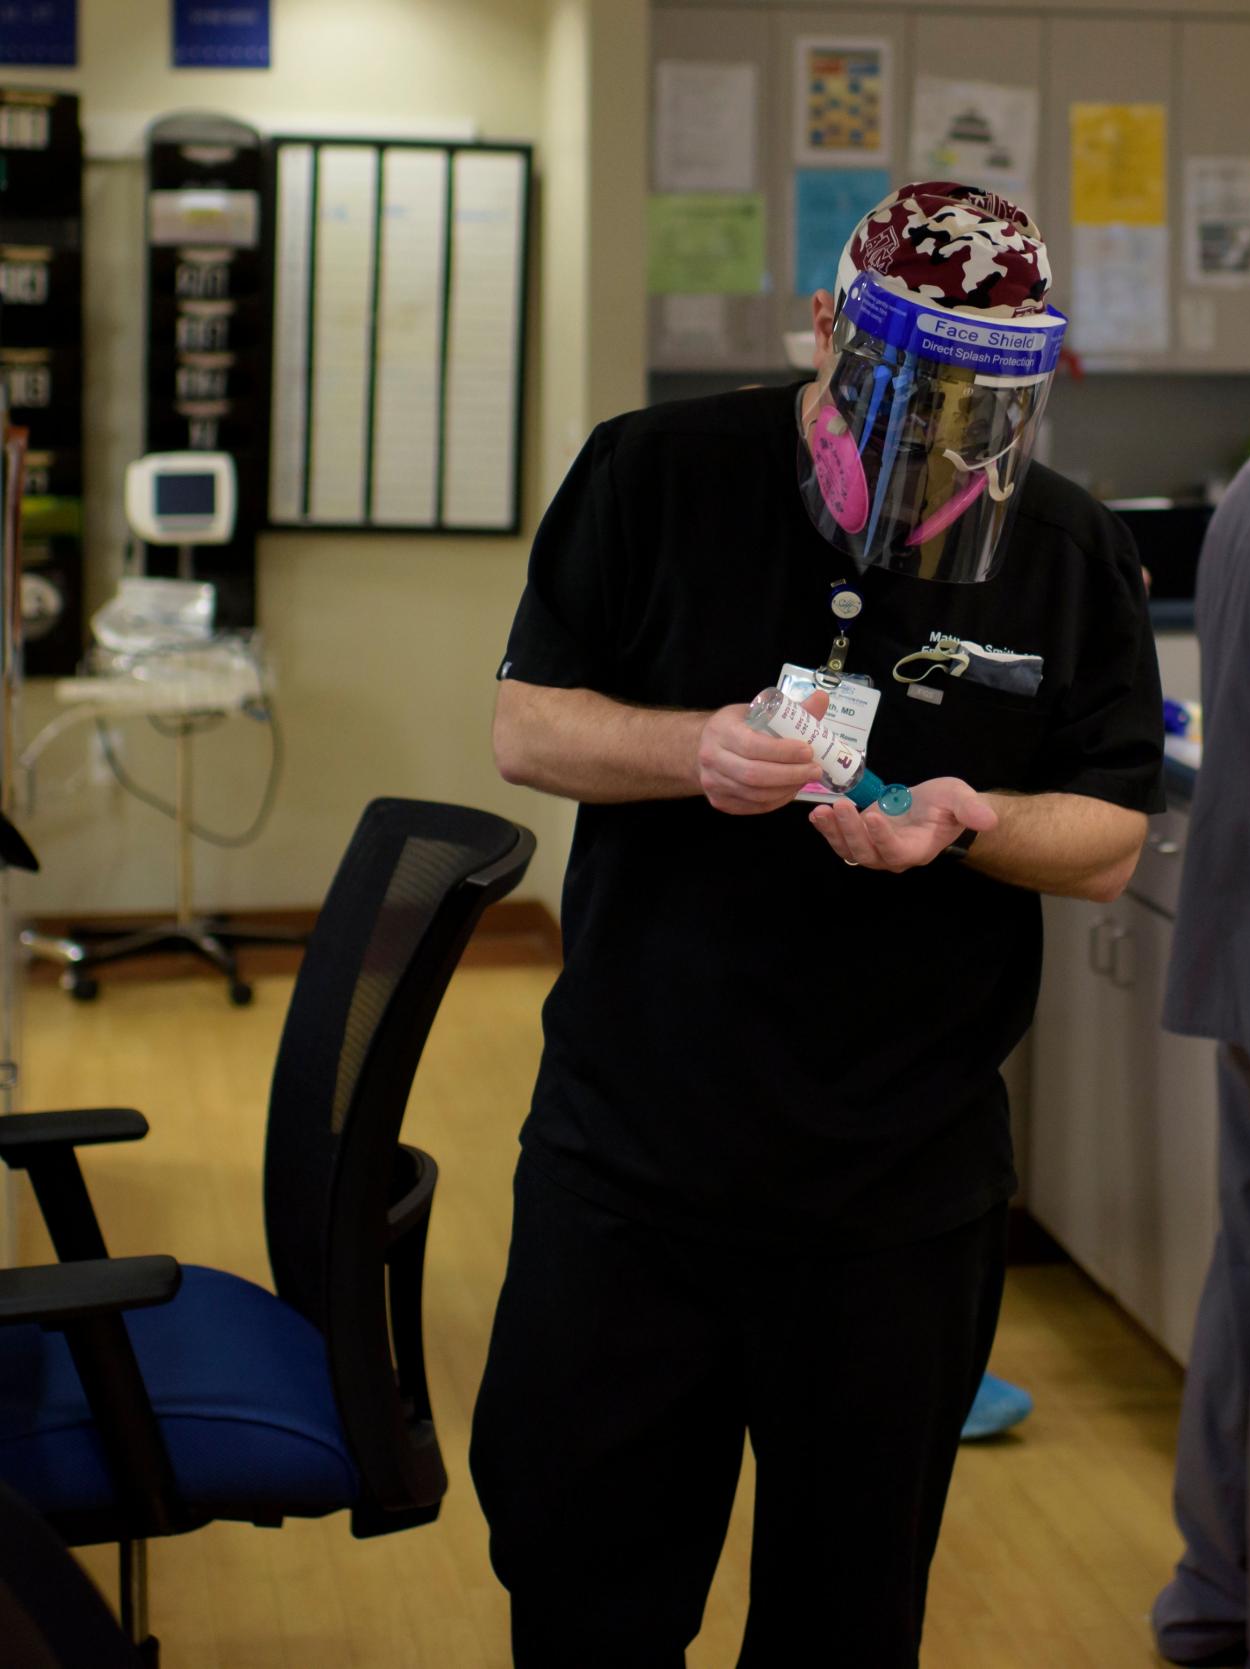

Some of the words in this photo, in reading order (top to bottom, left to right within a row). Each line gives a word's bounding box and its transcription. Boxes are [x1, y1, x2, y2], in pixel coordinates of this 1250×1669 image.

[934, 320, 979, 343] Face
[987, 331, 1035, 349] Shield
[922, 338, 954, 356] Direct
[955, 347, 991, 364] Splash
[992, 352, 1035, 368] Protection
[841, 706, 855, 717] MD
